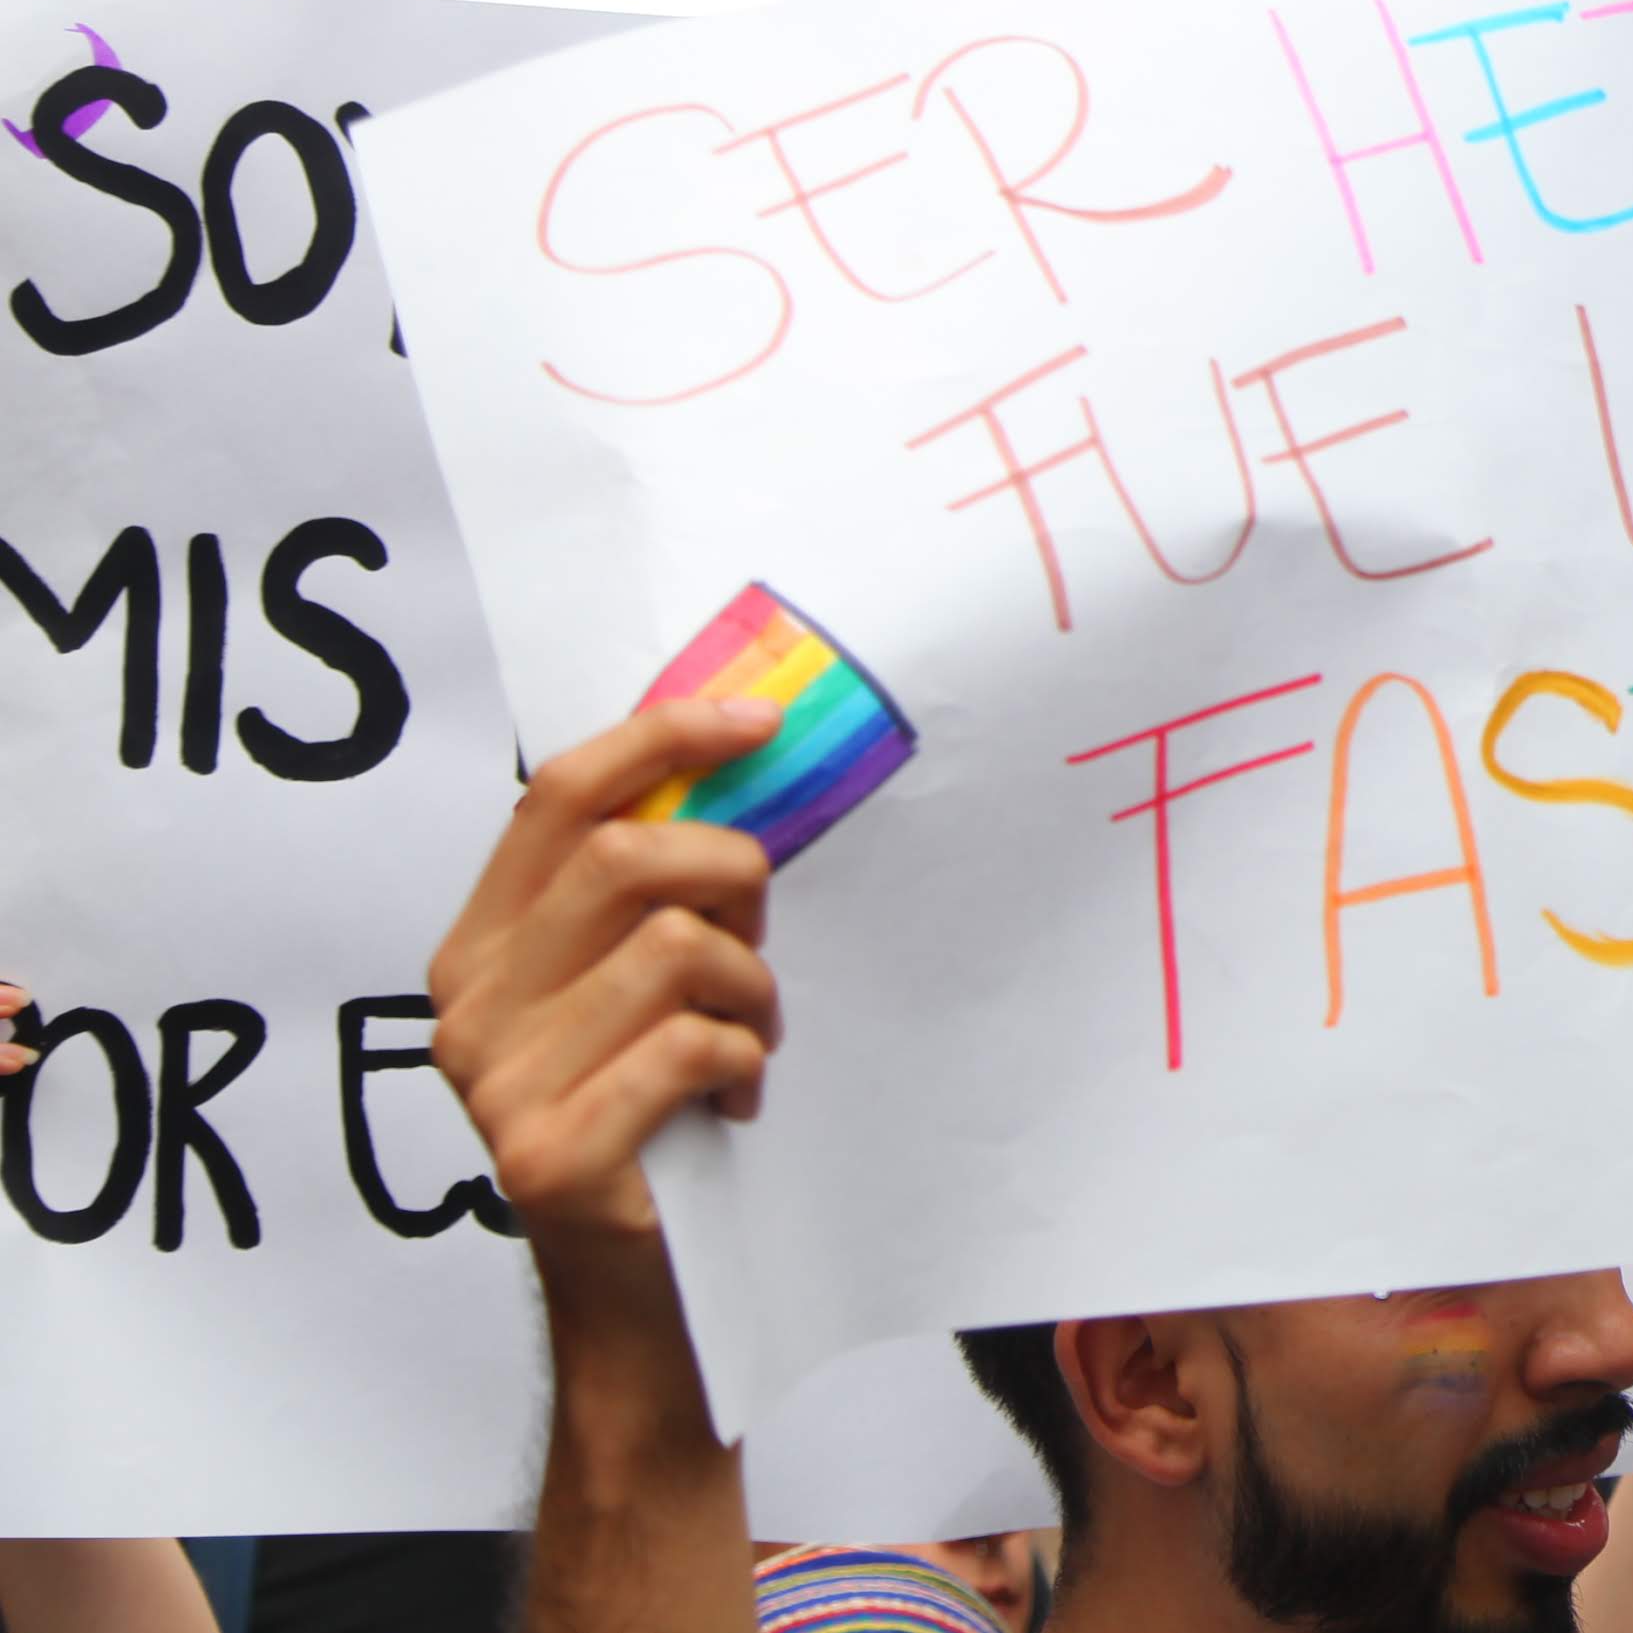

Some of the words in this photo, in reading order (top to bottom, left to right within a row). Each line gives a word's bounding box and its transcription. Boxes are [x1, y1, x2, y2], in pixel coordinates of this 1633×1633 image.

[10, 62, 410, 356] SO
[535, 34, 1234, 406] SER
[905, 317, 1494, 634] FUE
